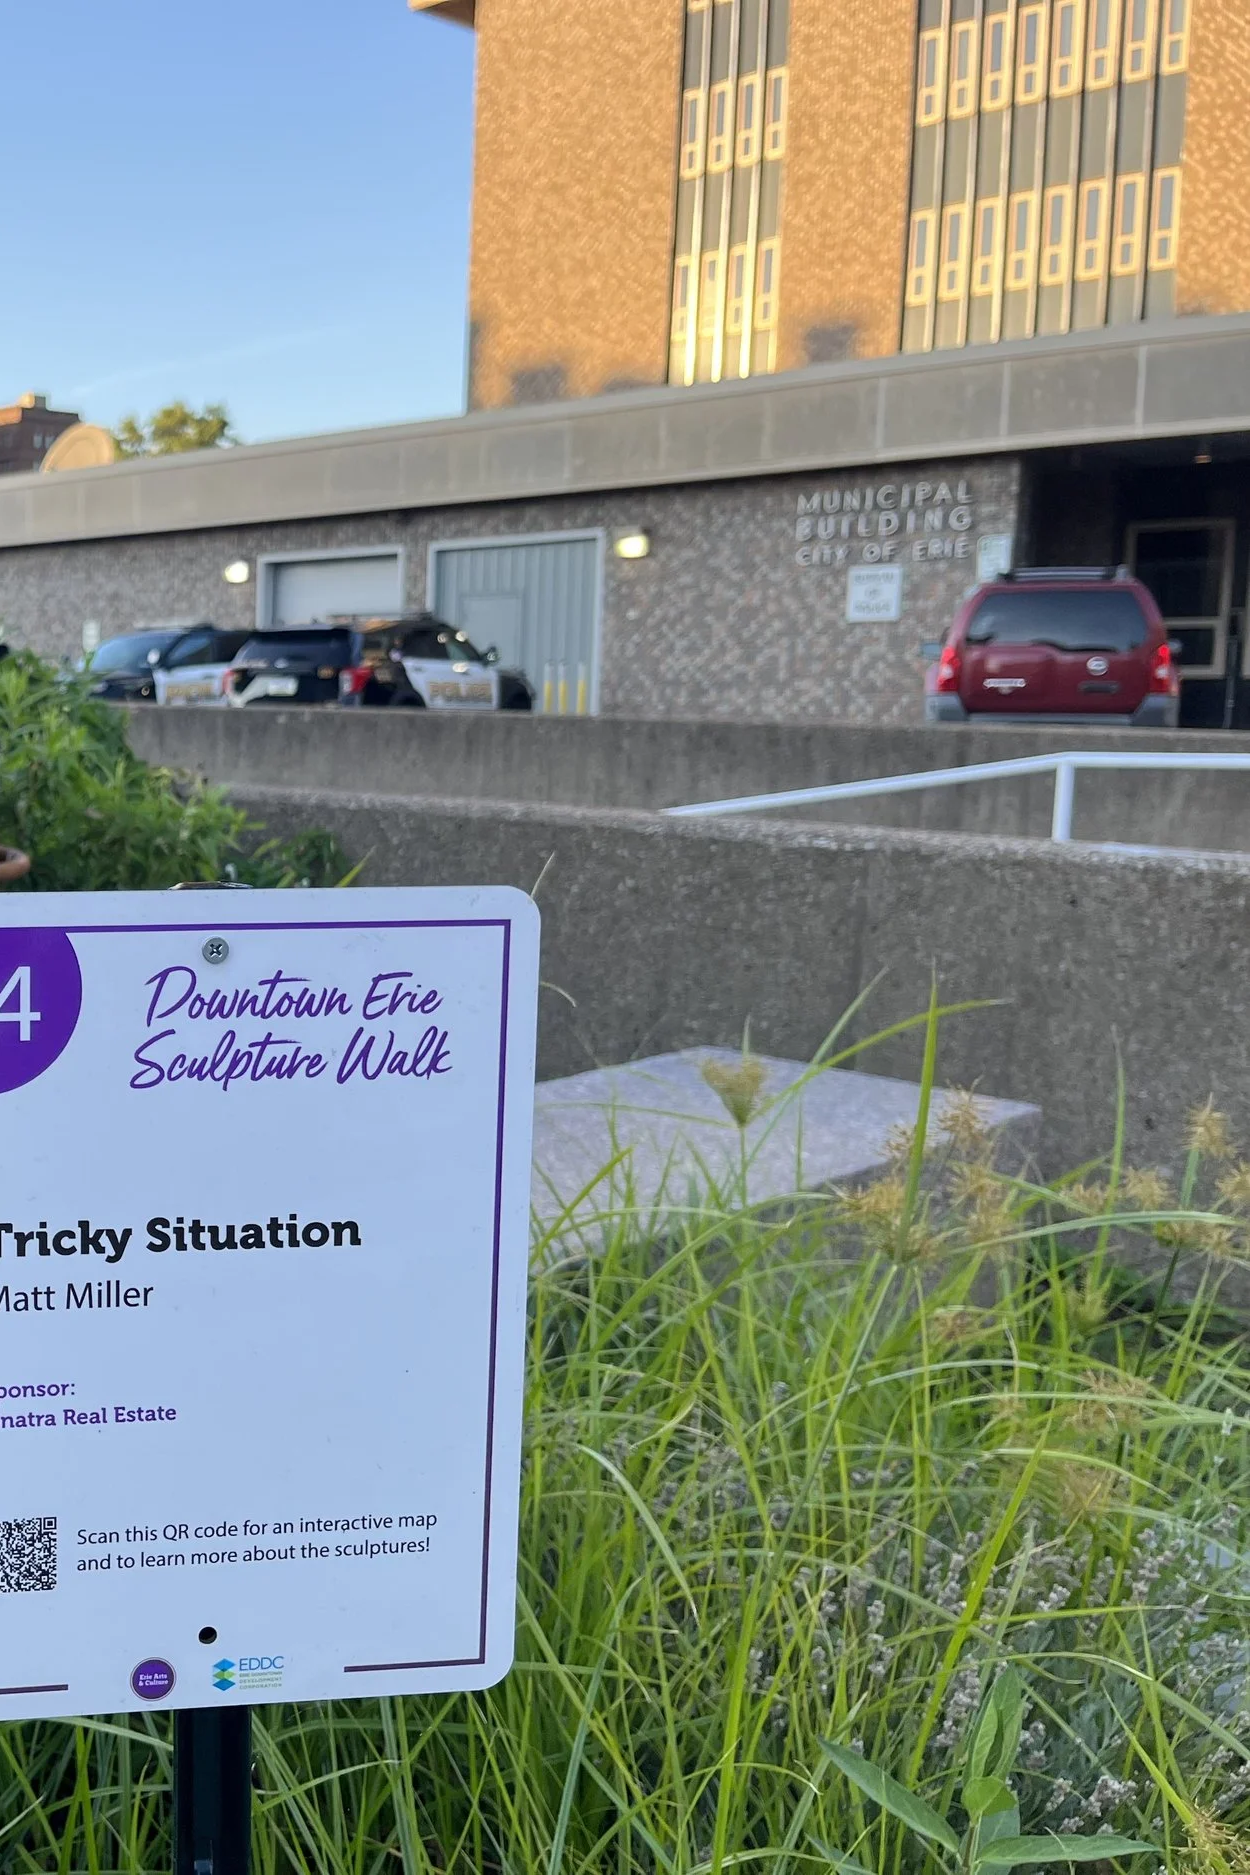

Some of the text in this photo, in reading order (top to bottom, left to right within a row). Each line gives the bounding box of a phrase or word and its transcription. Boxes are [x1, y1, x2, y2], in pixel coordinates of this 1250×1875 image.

[796, 480, 974, 514] MUNICIPAL
[795, 505, 973, 542] BUILDING
[795, 536, 971, 566] CITY OF ERIE
[144, 961, 444, 1028] Downtown Erie
[129, 1025, 453, 1092] Sculpture Walk
[145, 1213, 362, 1253] Situation
[65, 1279, 154, 1310] Miller
[62, 1407, 108, 1426] Real
[113, 1405, 177, 1423] Estate
[77, 1514, 438, 1545] Scan this QR code for an interactive map
[76, 1536, 430, 1572] and to learn more about the sculptures!
[239, 1655, 285, 1671] EDDC
